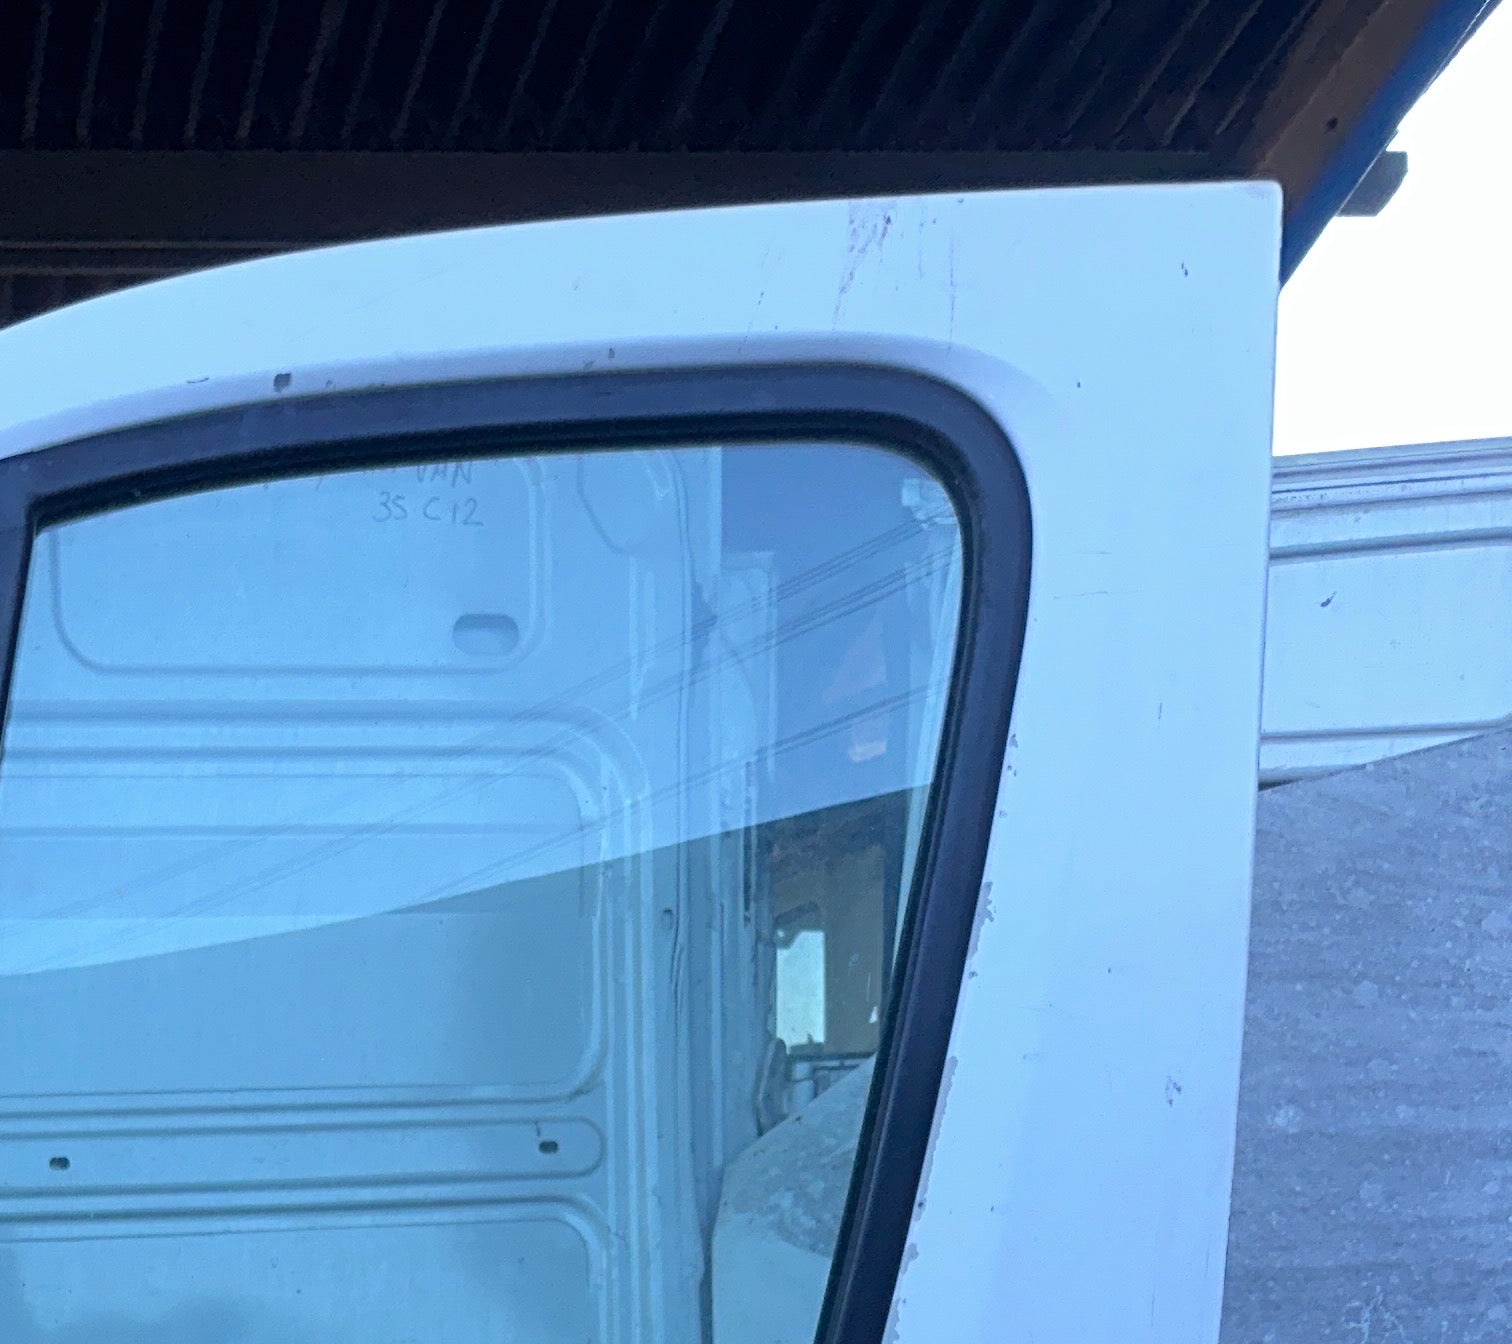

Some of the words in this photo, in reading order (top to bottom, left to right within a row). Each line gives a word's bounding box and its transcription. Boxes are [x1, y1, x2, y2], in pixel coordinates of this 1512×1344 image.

[372, 491, 408, 522] 35
[423, 496, 441, 521] C
[452, 497, 484, 527] 12
